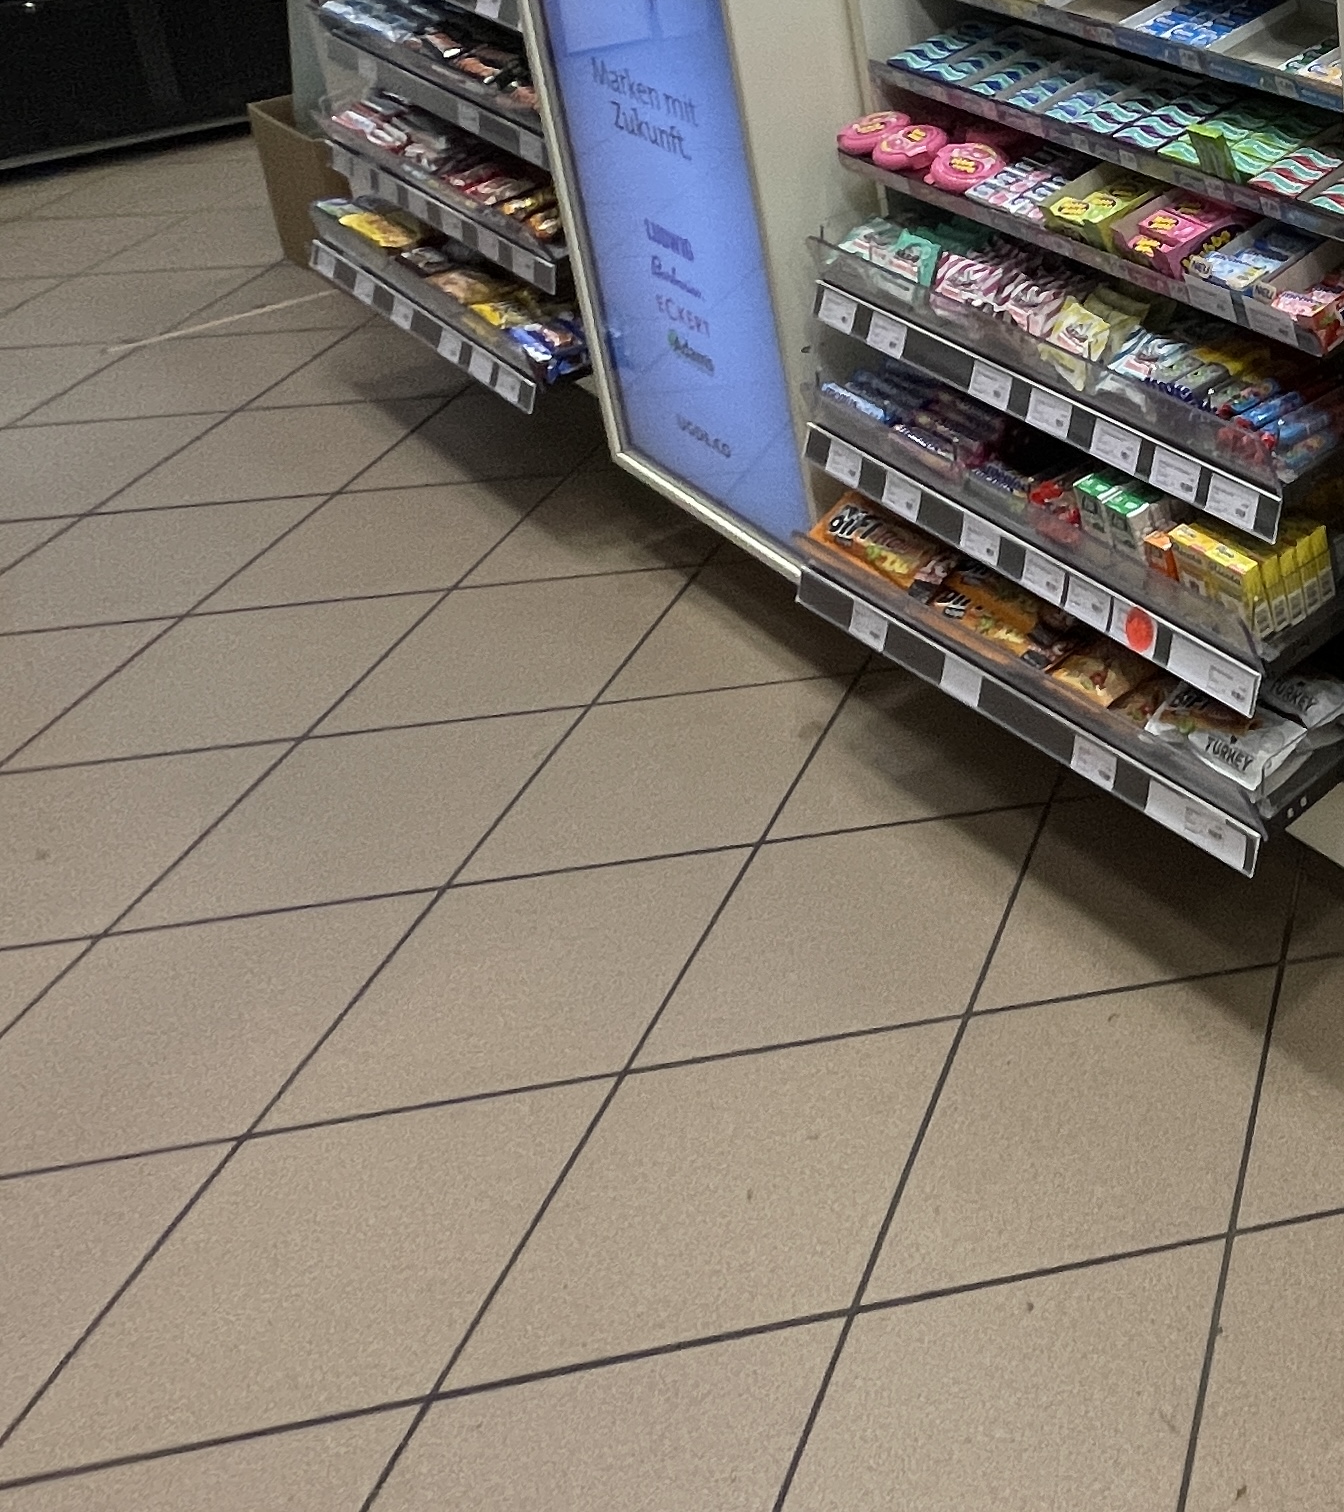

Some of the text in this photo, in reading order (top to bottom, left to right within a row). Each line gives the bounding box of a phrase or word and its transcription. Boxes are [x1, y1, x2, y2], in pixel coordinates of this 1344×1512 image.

[590, 56, 699, 127] Marken mit
[1204, 734, 1253, 772] TURKEY
